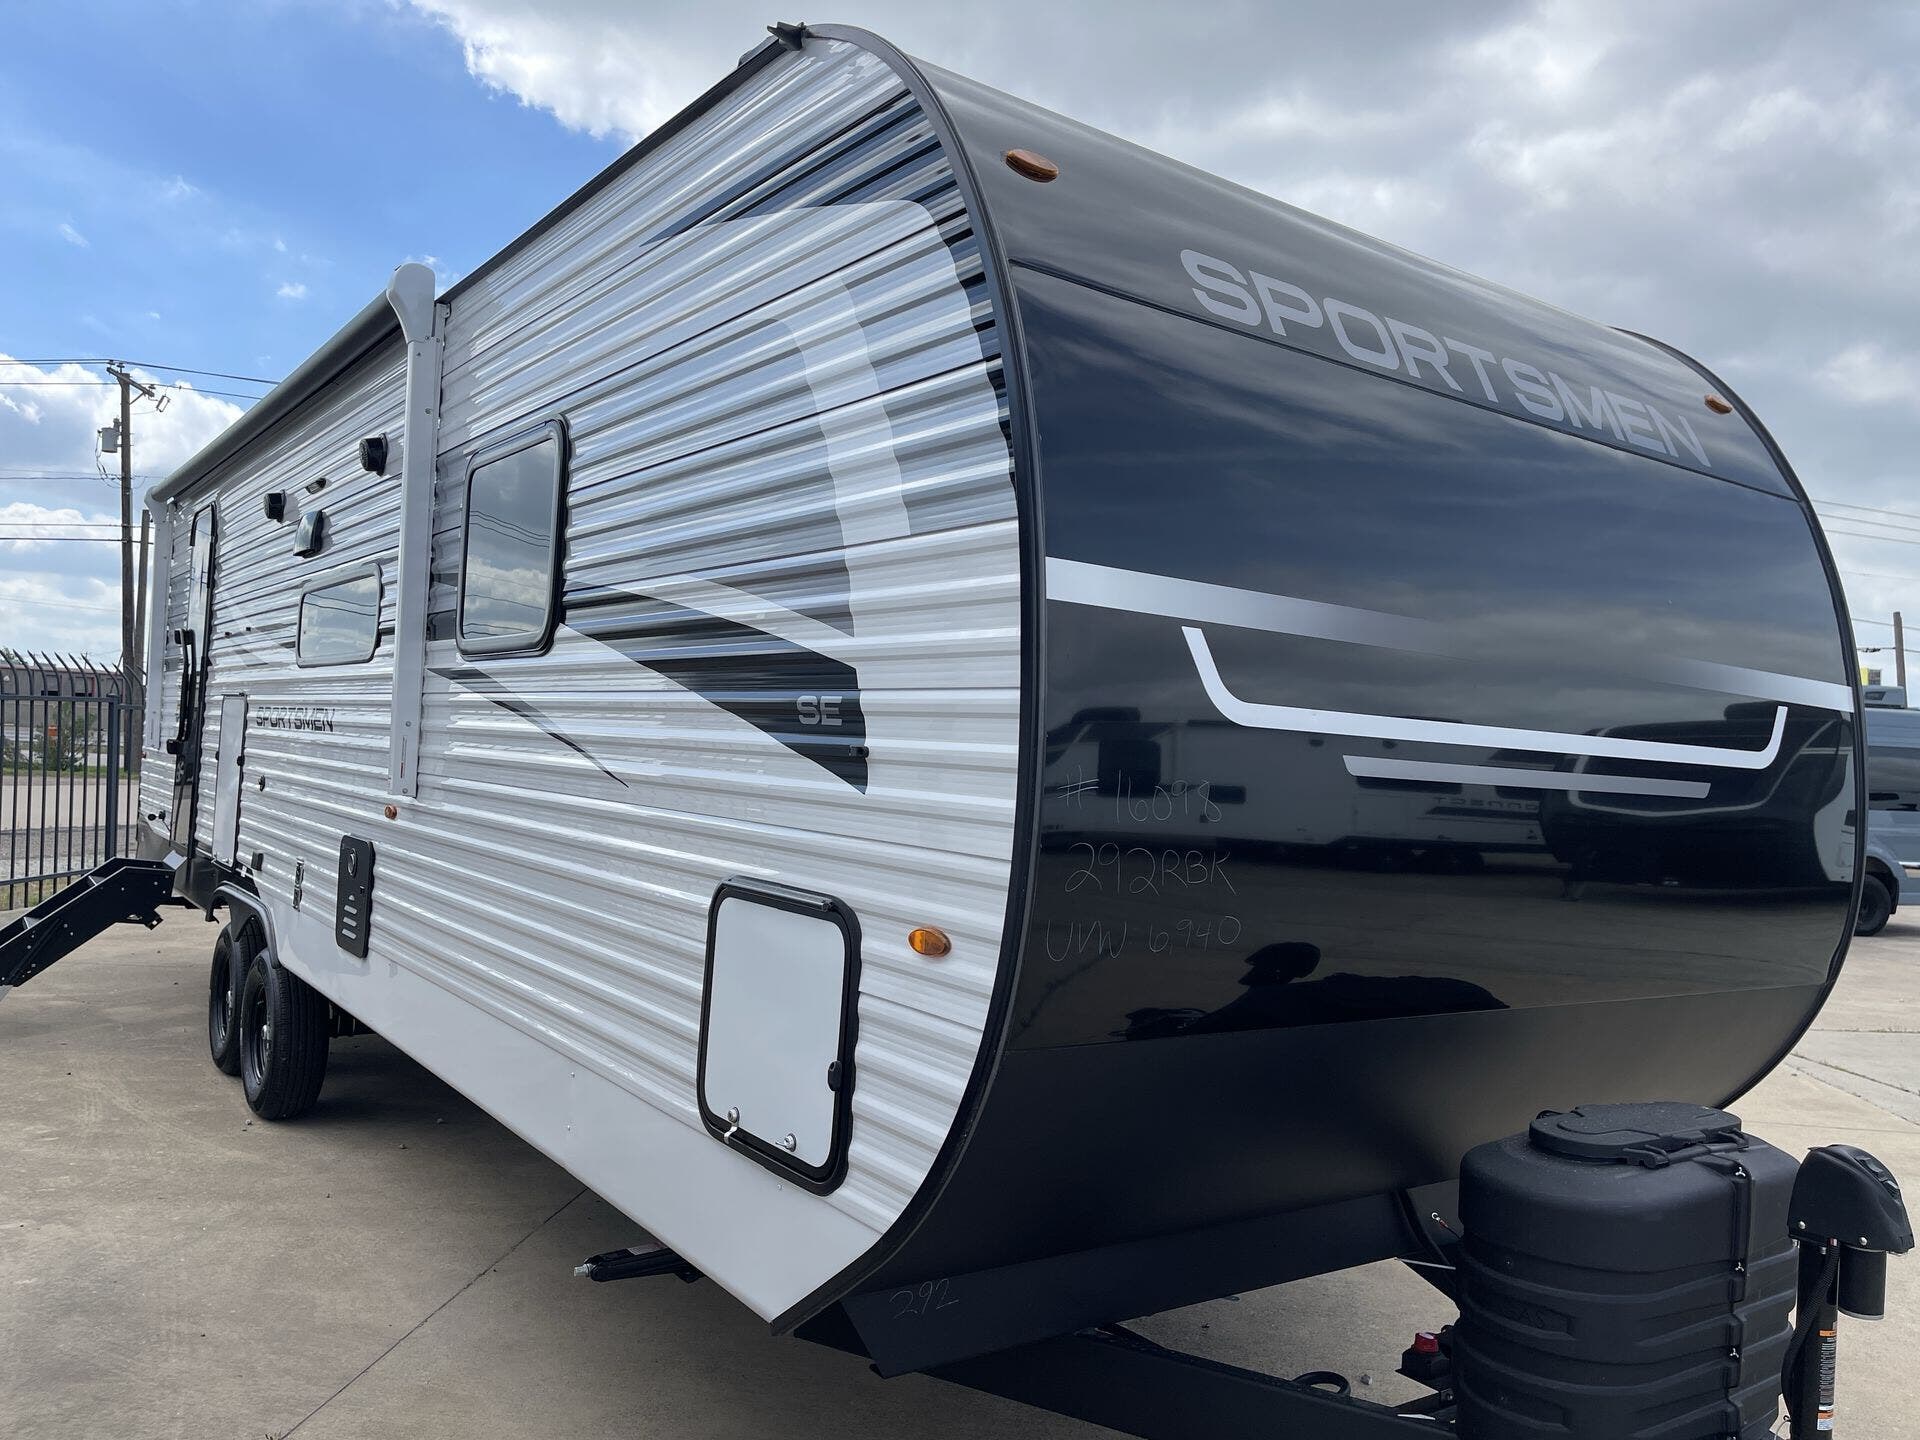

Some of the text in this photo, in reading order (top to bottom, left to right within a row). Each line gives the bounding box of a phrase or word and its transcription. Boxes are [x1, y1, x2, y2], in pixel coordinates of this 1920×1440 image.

[1180, 249, 1711, 467] SPORTSMEN
[256, 706, 335, 732] SPORTSMEN
[796, 695, 842, 726] SE
[1116, 769, 1222, 824] 16098
[1065, 842, 1236, 896] 292RBK
[890, 1278, 959, 1319] 292
